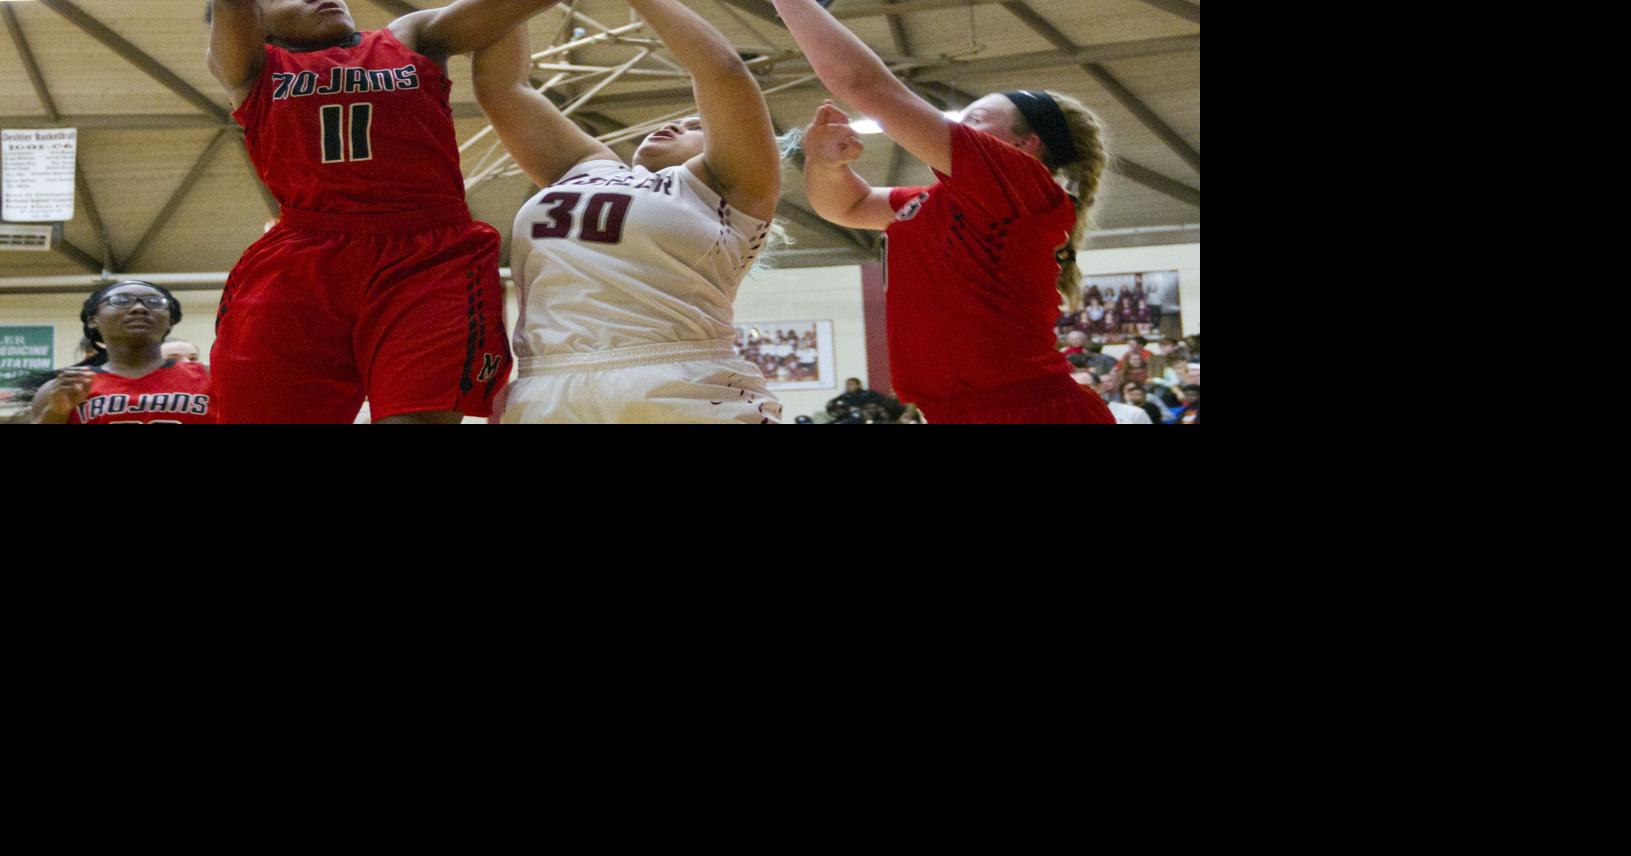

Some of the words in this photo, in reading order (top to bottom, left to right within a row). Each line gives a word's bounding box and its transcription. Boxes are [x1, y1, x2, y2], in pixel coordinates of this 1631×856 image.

[271, 64, 420, 101] ROJANS
[319, 102, 373, 164] 11
[530, 191, 633, 245] 30
[0, 335, 25, 345] ER
[476, 353, 501, 382] M
